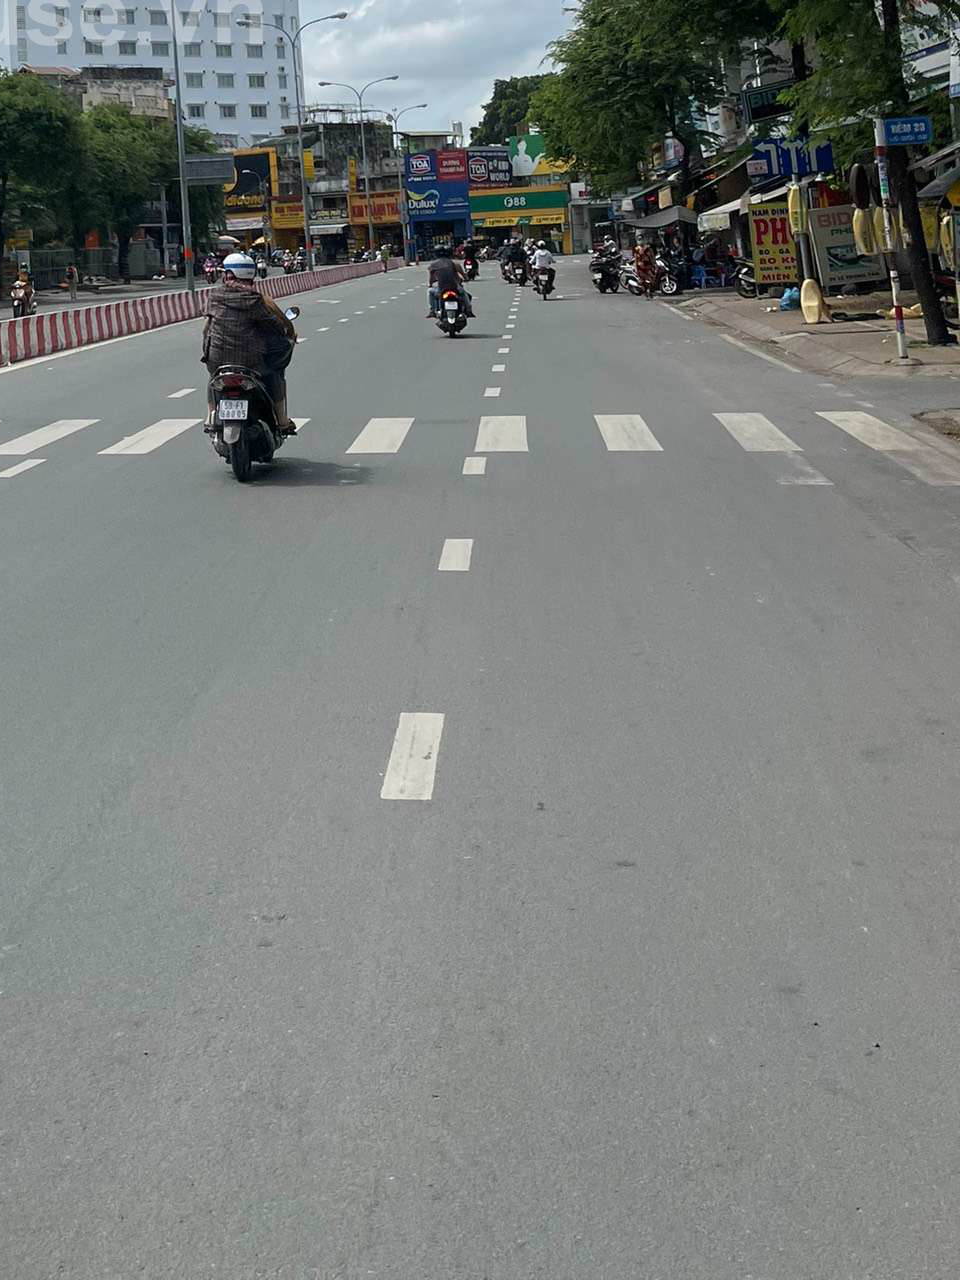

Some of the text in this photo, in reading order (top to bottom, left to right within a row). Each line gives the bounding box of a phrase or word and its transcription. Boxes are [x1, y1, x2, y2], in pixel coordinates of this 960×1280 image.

[411, 160, 429, 169] TOA
[470, 164, 486, 174] TOA
[408, 199, 436, 209] Dulux
[503, 196, 527, 208] F88
[752, 217, 789, 246] PH
